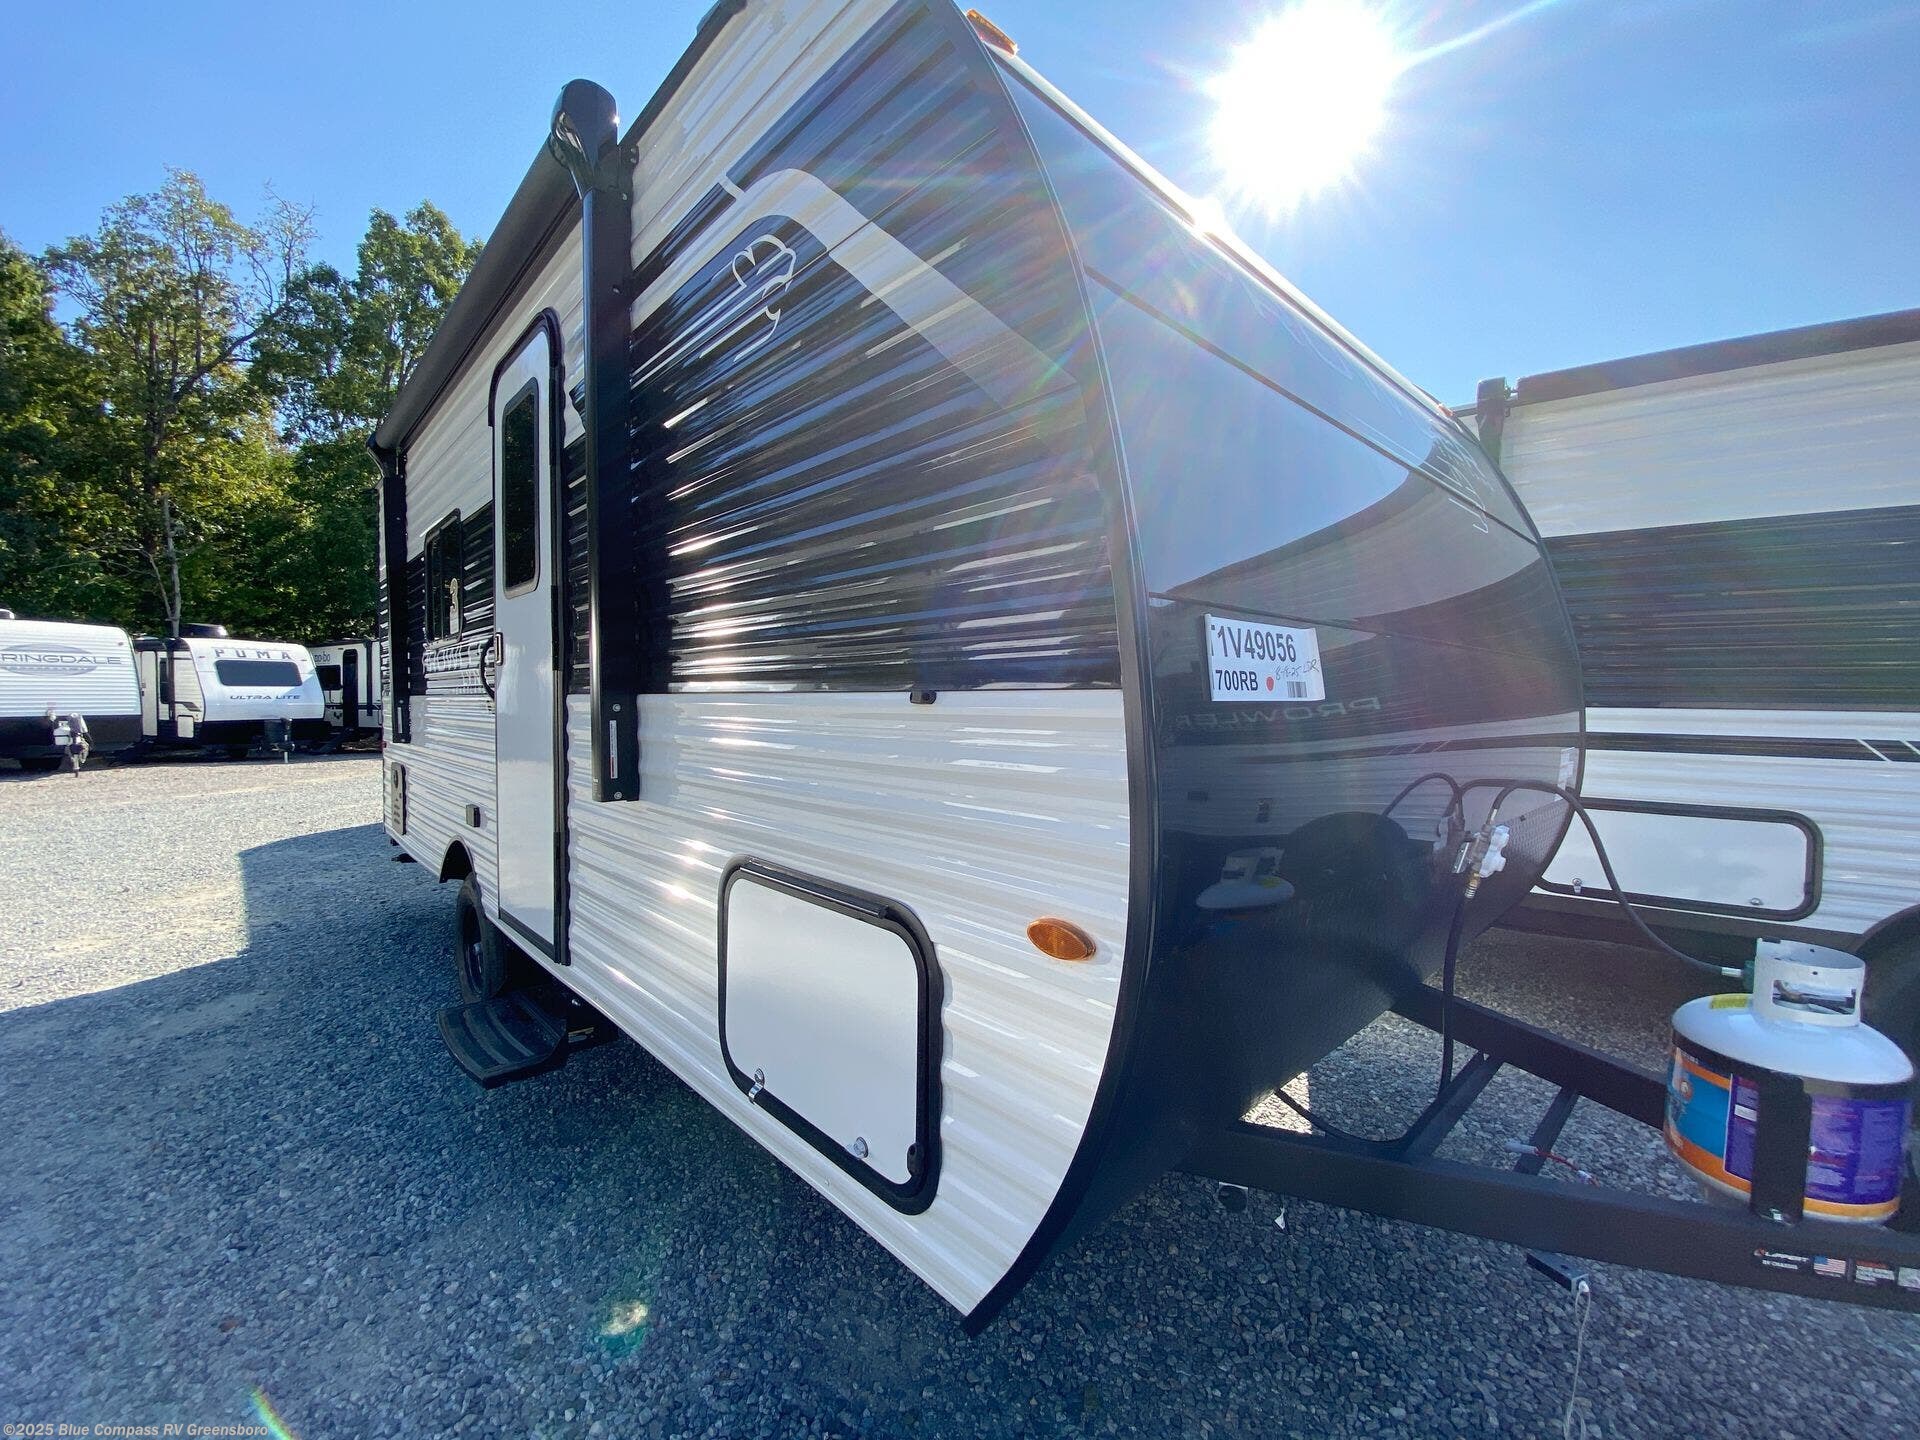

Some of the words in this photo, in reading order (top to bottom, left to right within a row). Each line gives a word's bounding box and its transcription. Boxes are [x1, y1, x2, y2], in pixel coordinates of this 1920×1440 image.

[215, 648, 292, 660] PUMA
[1217, 625, 1297, 663] 1V49056
[1215, 669, 1259, 691] 700RB
